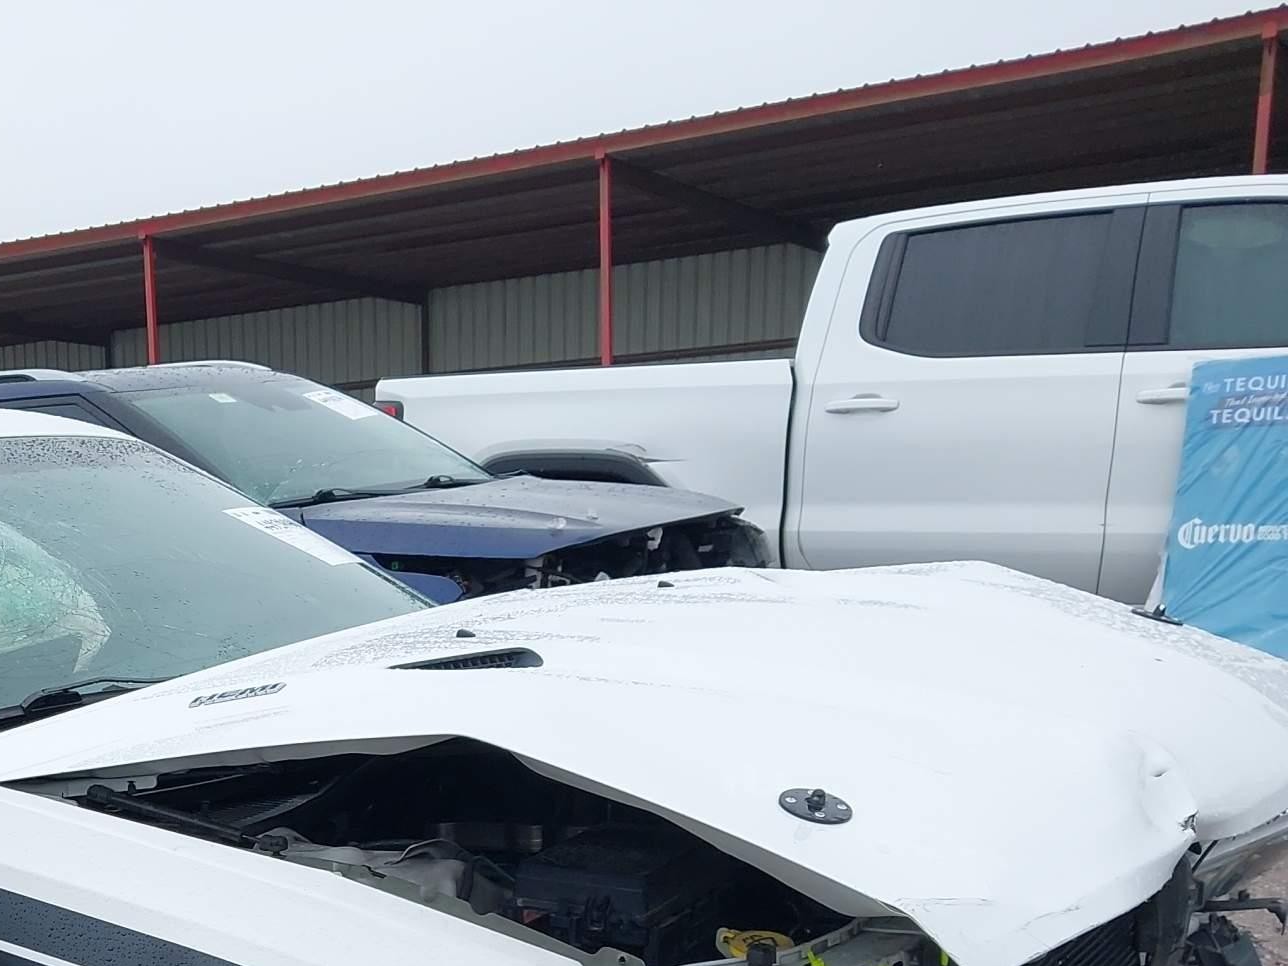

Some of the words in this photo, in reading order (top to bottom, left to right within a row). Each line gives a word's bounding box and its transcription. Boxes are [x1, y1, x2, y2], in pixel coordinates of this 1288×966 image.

[1210, 406, 1288, 425] TEQUIL
[1177, 518, 1255, 549] Cuervo
[189, 682, 287, 708] HEMI
